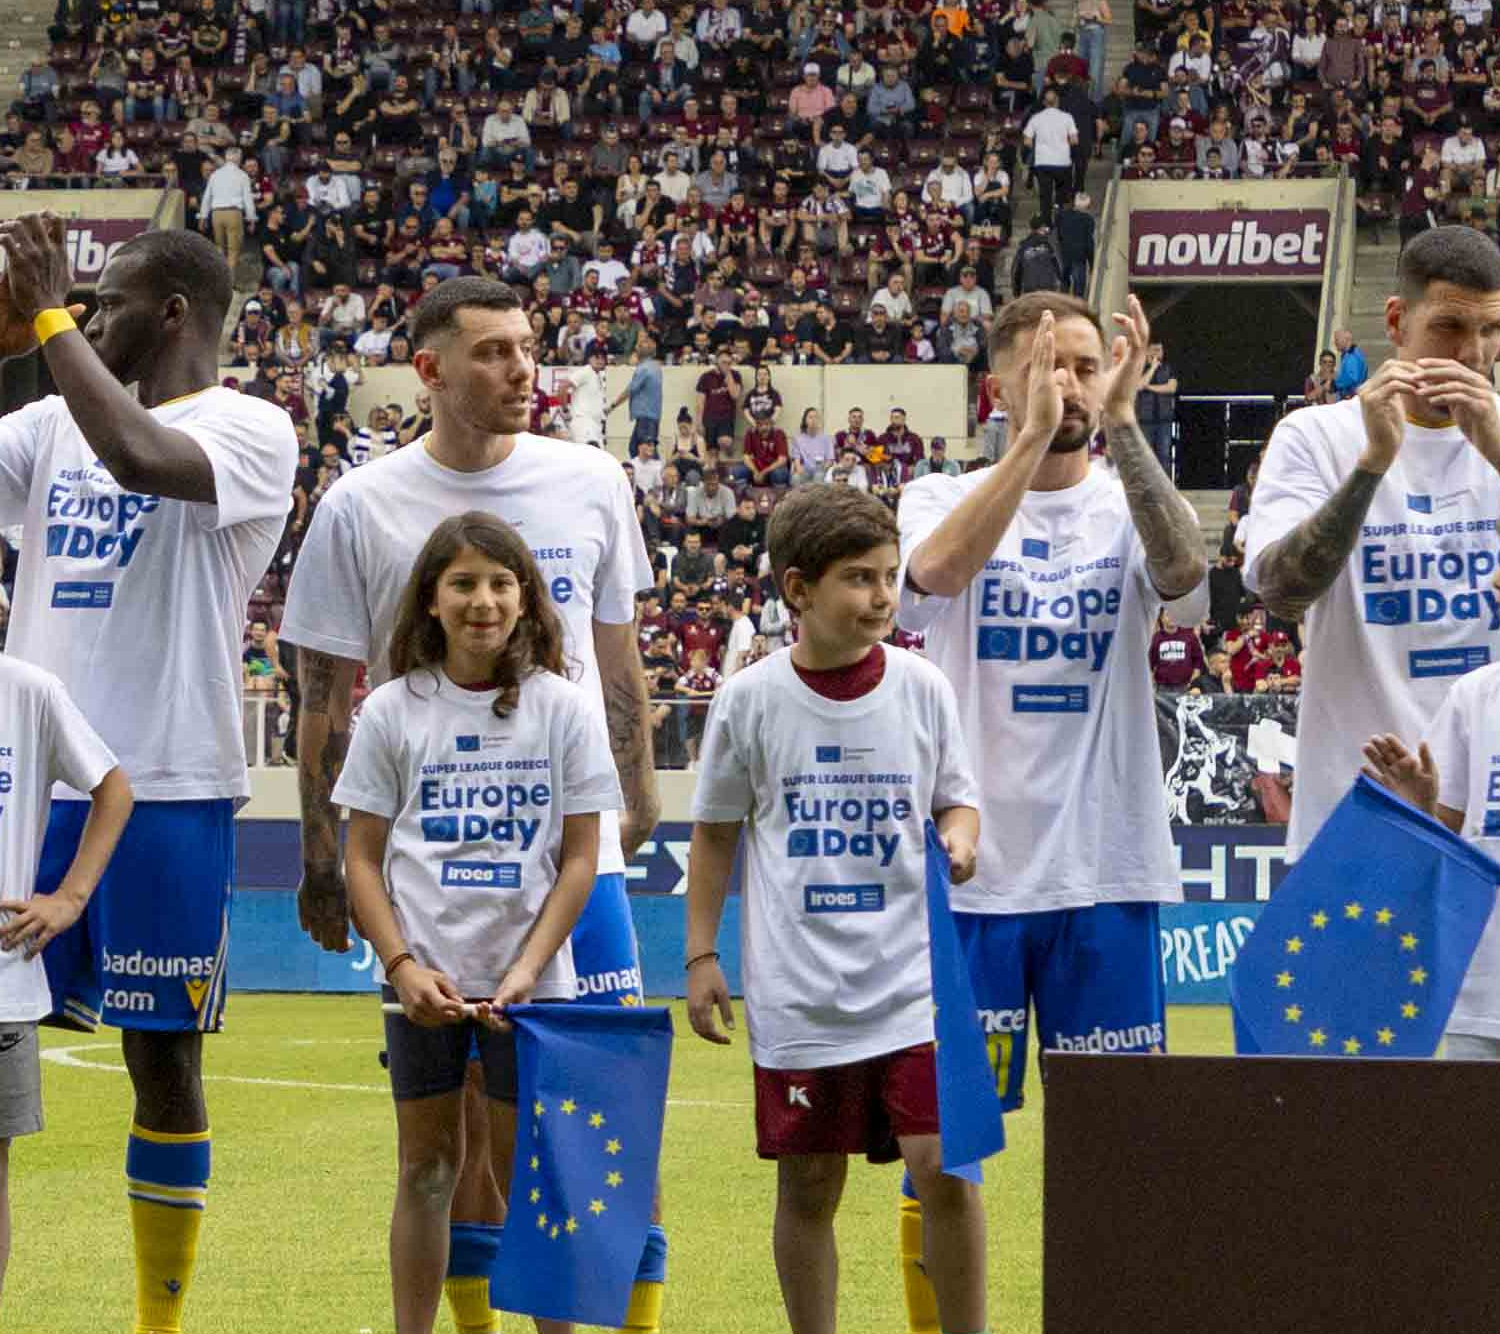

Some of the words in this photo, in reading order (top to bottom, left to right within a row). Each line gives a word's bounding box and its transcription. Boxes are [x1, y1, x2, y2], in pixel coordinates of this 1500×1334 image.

[1136, 221, 1323, 266] novibet
[1363, 523, 1407, 538] SUPER
[980, 577, 1122, 629] Europe
[1026, 626, 1115, 672] Day
[459, 760, 504, 773] LEAGUE
[504, 759, 550, 770] GREECE
[818, 773, 864, 785] LEAGUE
[421, 779, 551, 817] Europe
[783, 791, 912, 832] Europe
[463, 814, 542, 852] Day
[823, 828, 901, 867] Day
[103, 945, 215, 978] badounas
